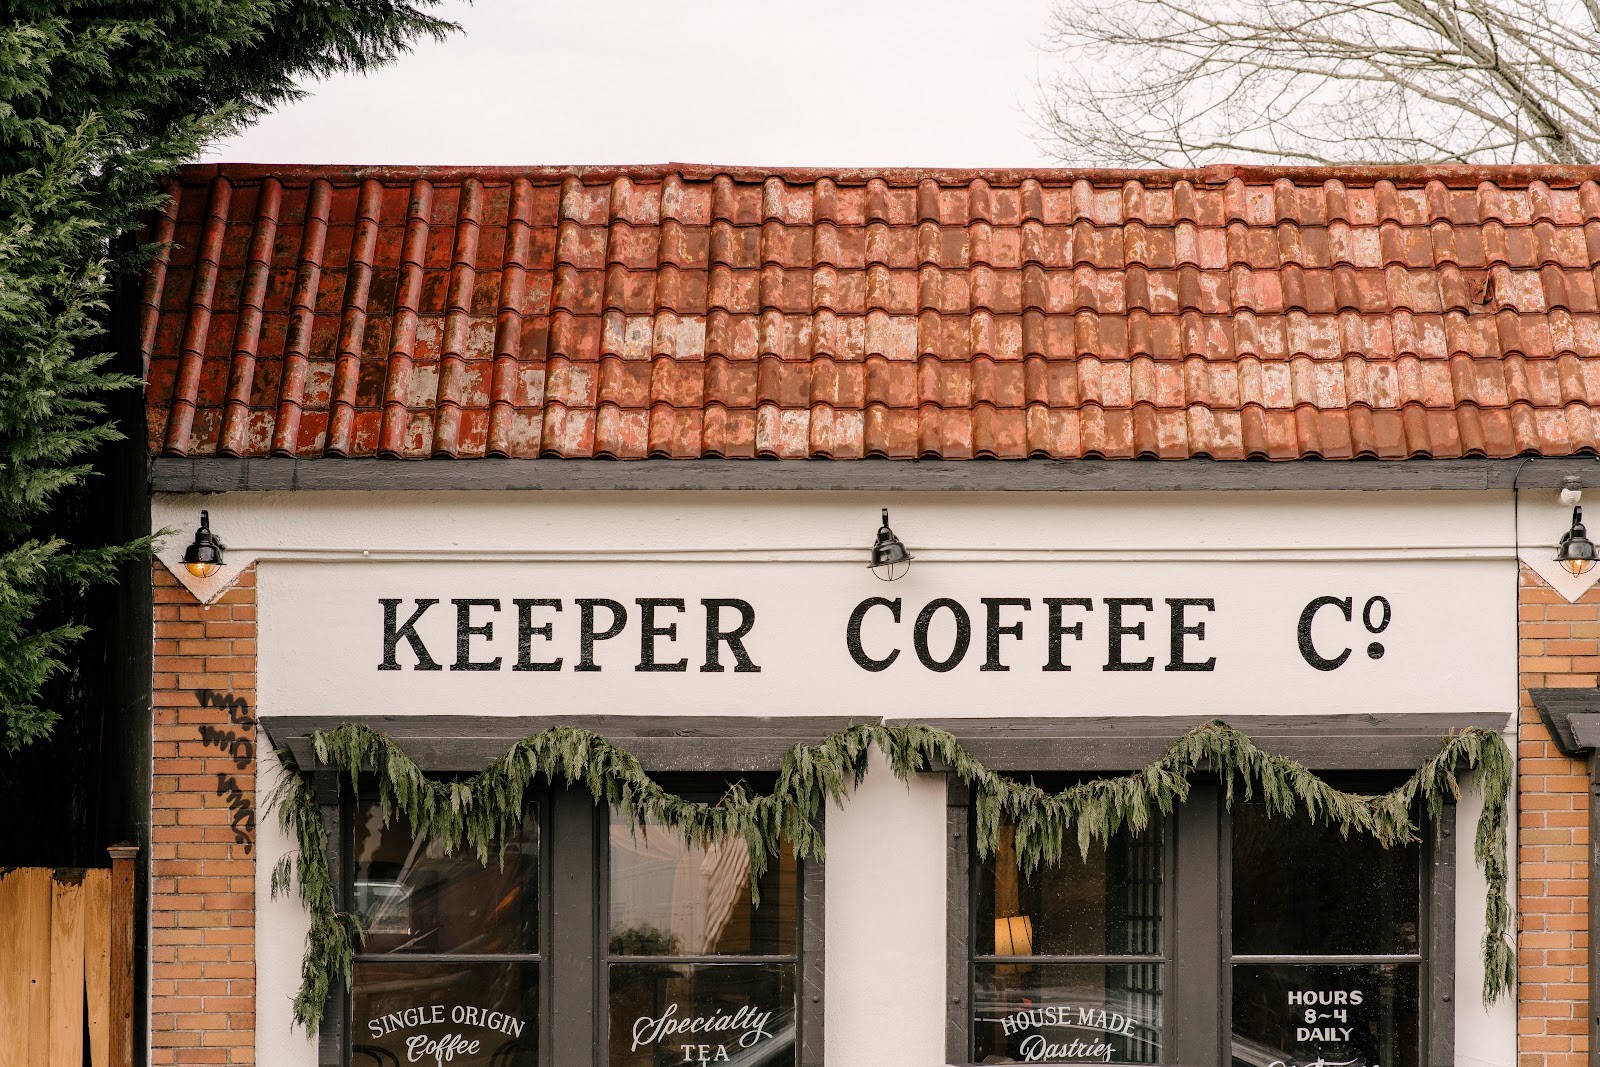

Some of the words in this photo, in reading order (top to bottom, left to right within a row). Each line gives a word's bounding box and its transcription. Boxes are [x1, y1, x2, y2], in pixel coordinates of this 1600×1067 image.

[377, 597, 762, 673] KEEPER
[846, 596, 1217, 673] COFFEE
[1287, 990, 1364, 1006] HOURS
[367, 1004, 446, 1040] SINGLE
[451, 1005, 526, 1039] ORIGIN
[631, 1002, 774, 1053] Specialty
[1000, 1006, 1072, 1037] HOUSE
[1077, 1007, 1139, 1038] MADE
[1296, 1027, 1355, 1042] DAILY
[405, 1033, 481, 1063] Coffee
[680, 1044, 731, 1062] TEA
[1019, 1034, 1117, 1063] Pastries
